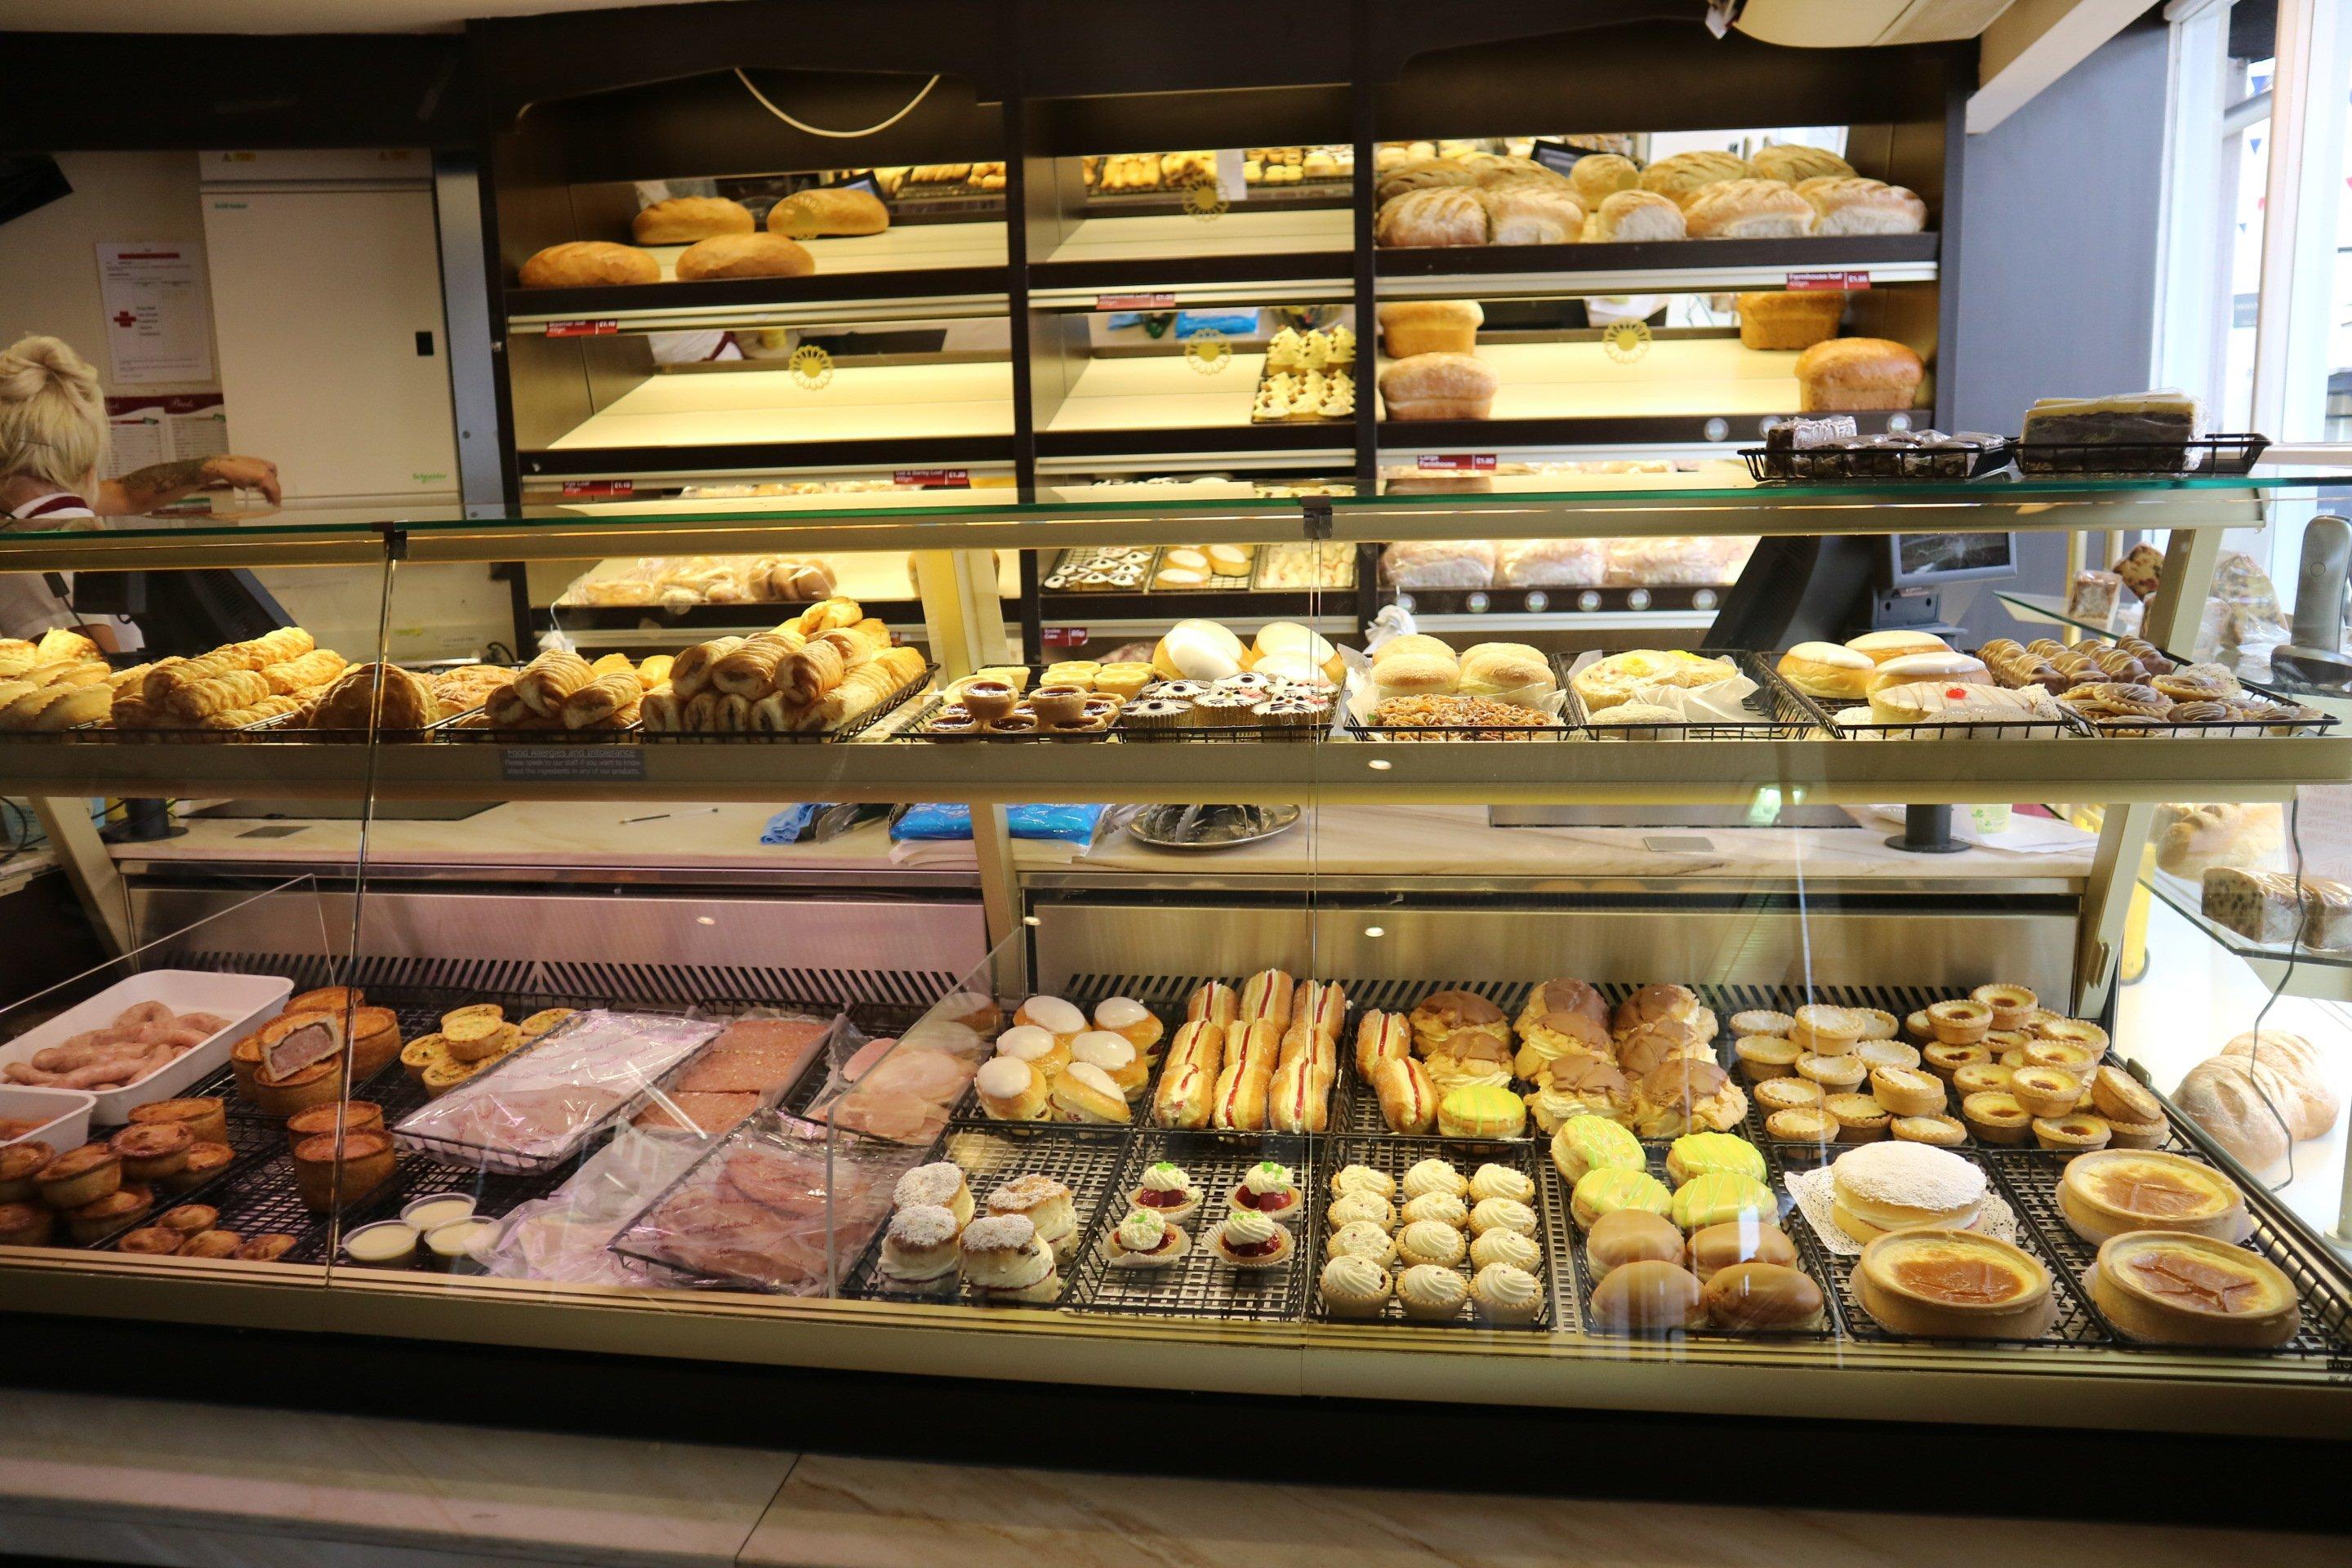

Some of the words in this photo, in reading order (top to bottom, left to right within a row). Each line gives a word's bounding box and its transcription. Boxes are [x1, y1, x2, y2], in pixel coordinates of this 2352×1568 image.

[532, 750, 566, 759] Allergies
[587, 750, 635, 758] Intolerance
[537, 768, 570, 777] ingredients
